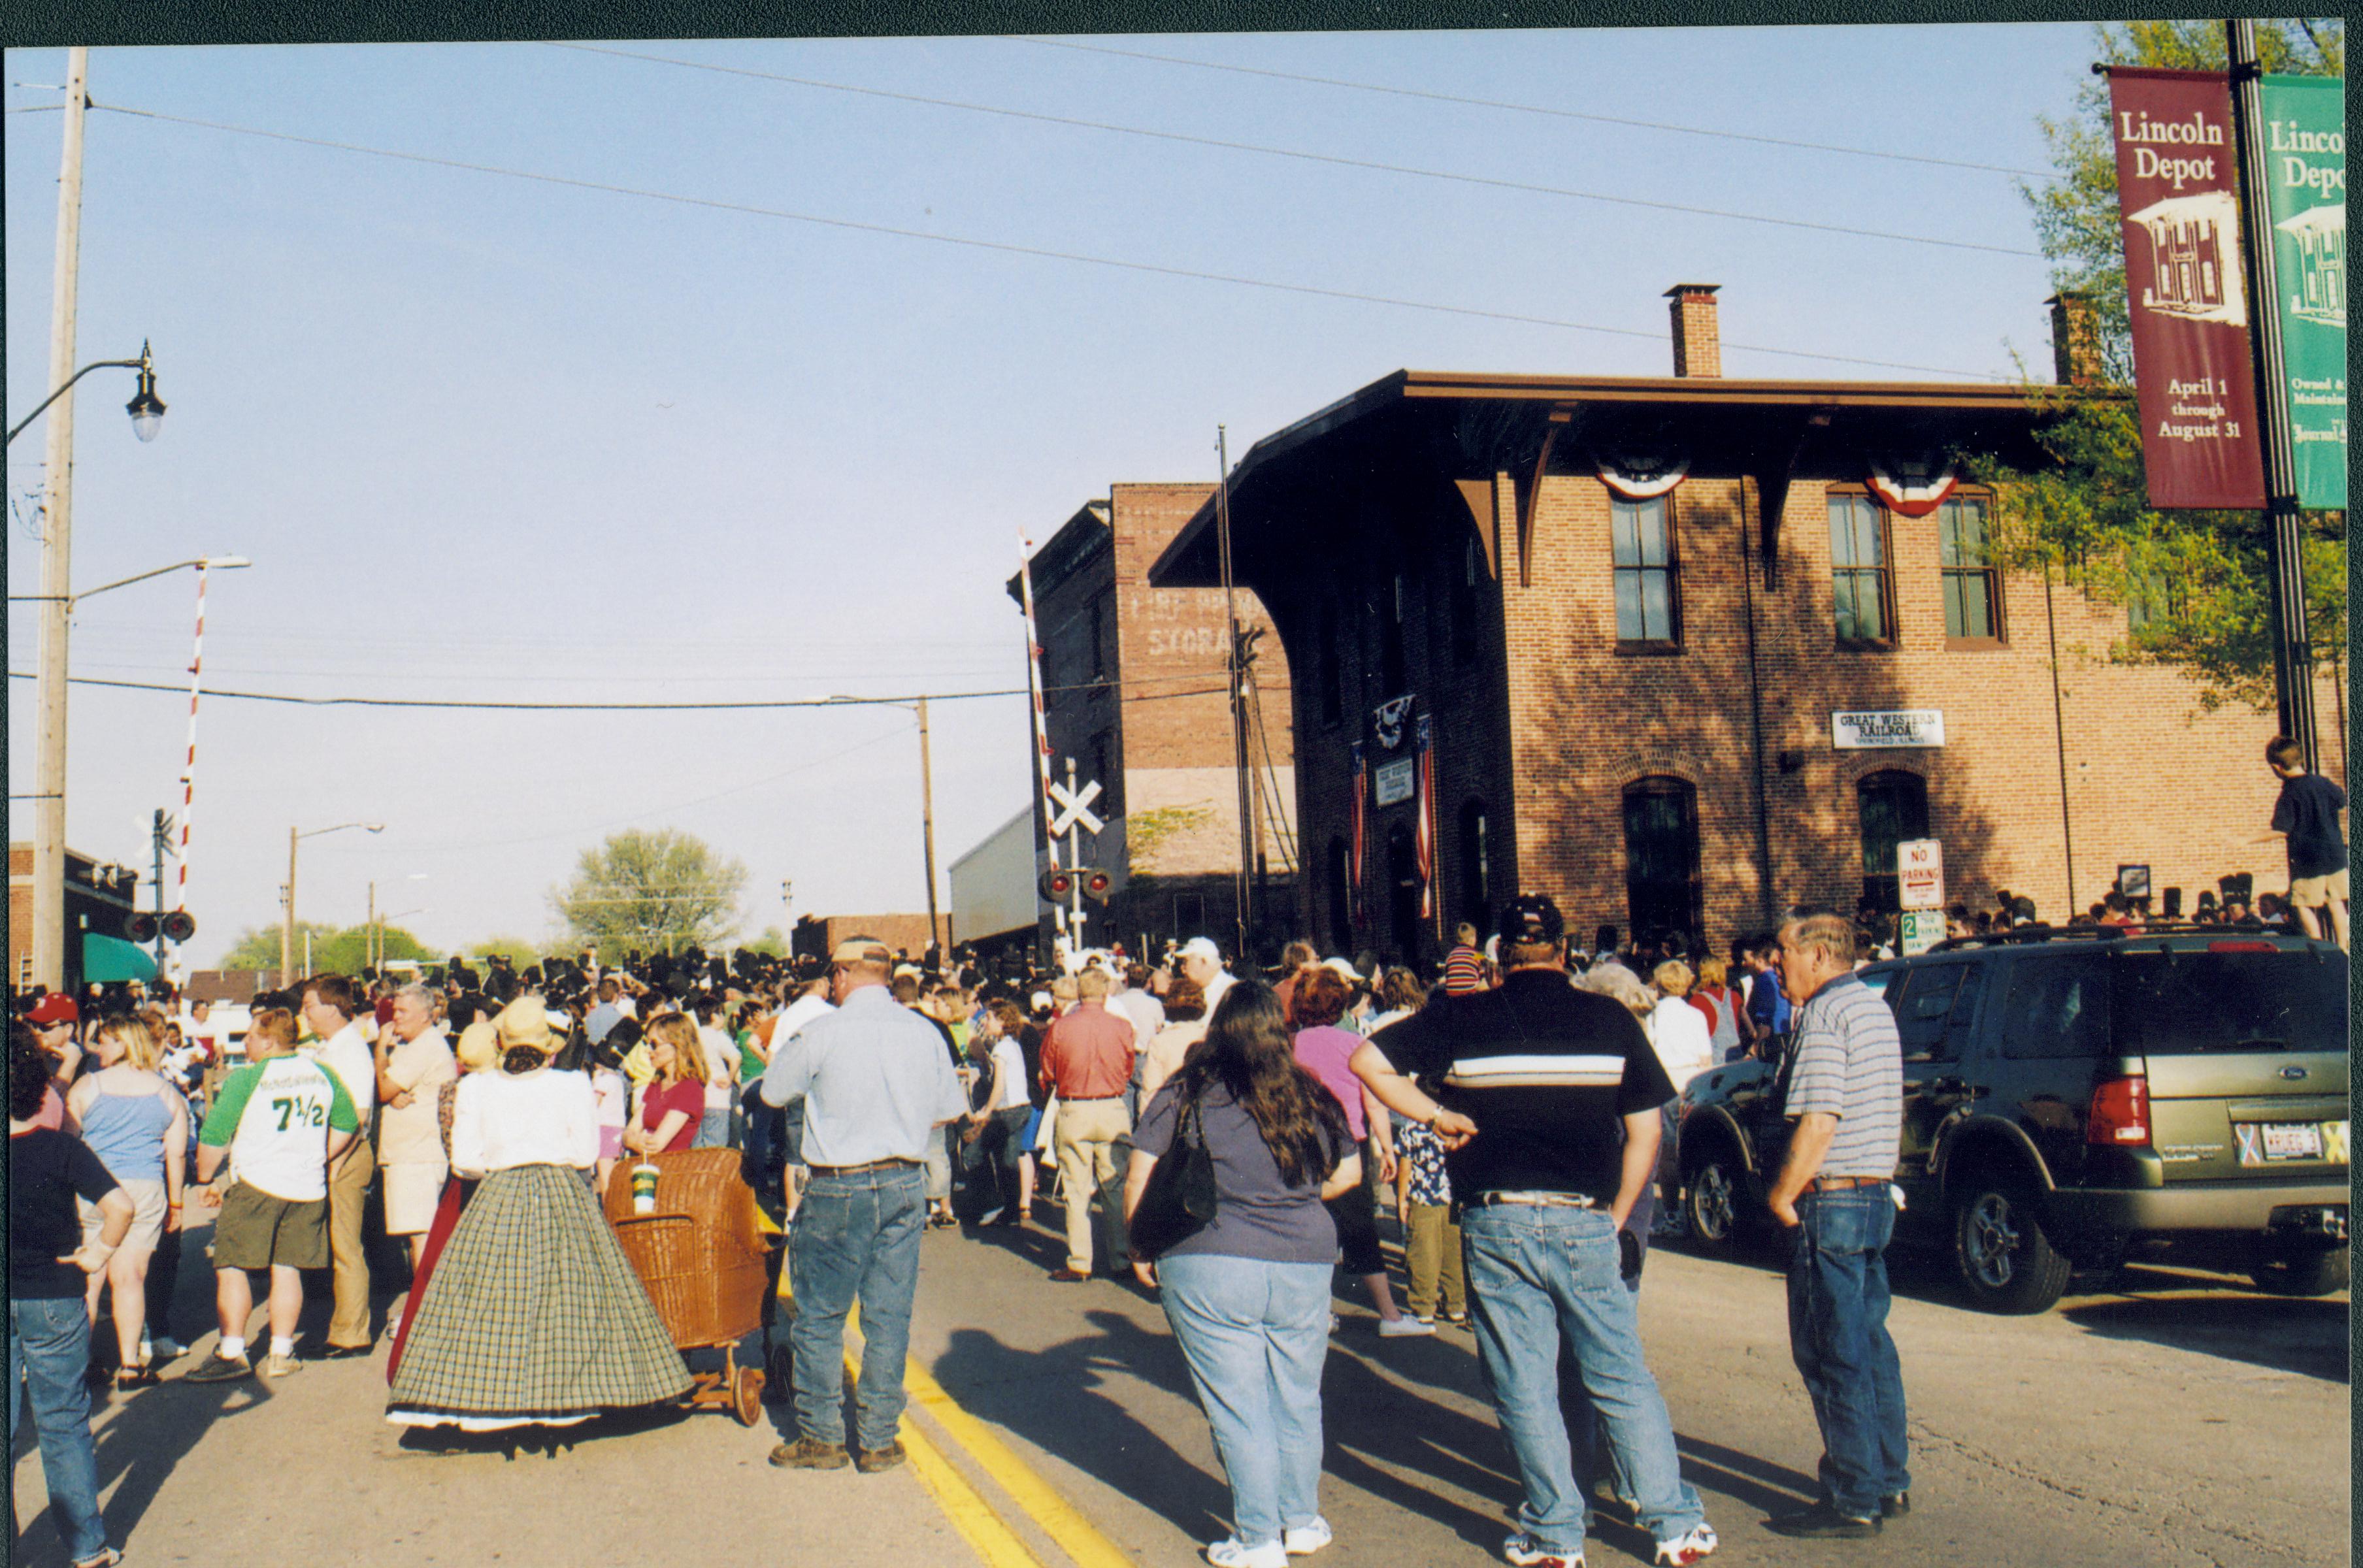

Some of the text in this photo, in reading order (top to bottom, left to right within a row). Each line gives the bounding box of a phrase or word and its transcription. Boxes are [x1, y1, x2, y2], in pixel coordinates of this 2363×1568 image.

[2120, 111, 2224, 145] Lincoln
[2269, 120, 2345, 154] Linco
[2134, 148, 2216, 189] Depot
[2168, 377, 2228, 400] April 1
[2291, 377, 2345, 390] Owned &
[2172, 402, 2225, 421] through
[2158, 421, 2241, 442] August 31
[1148, 626, 1266, 655] STORA
[1840, 713, 1936, 727] GREAT WESTERN
[1859, 725, 1921, 737] RAILROAD
[1911, 849, 1928, 862] NO
[1902, 867, 1939, 881] PARKING
[1904, 919, 1915, 936] 2
[2268, 1132, 2317, 1152] KRUEG 3
